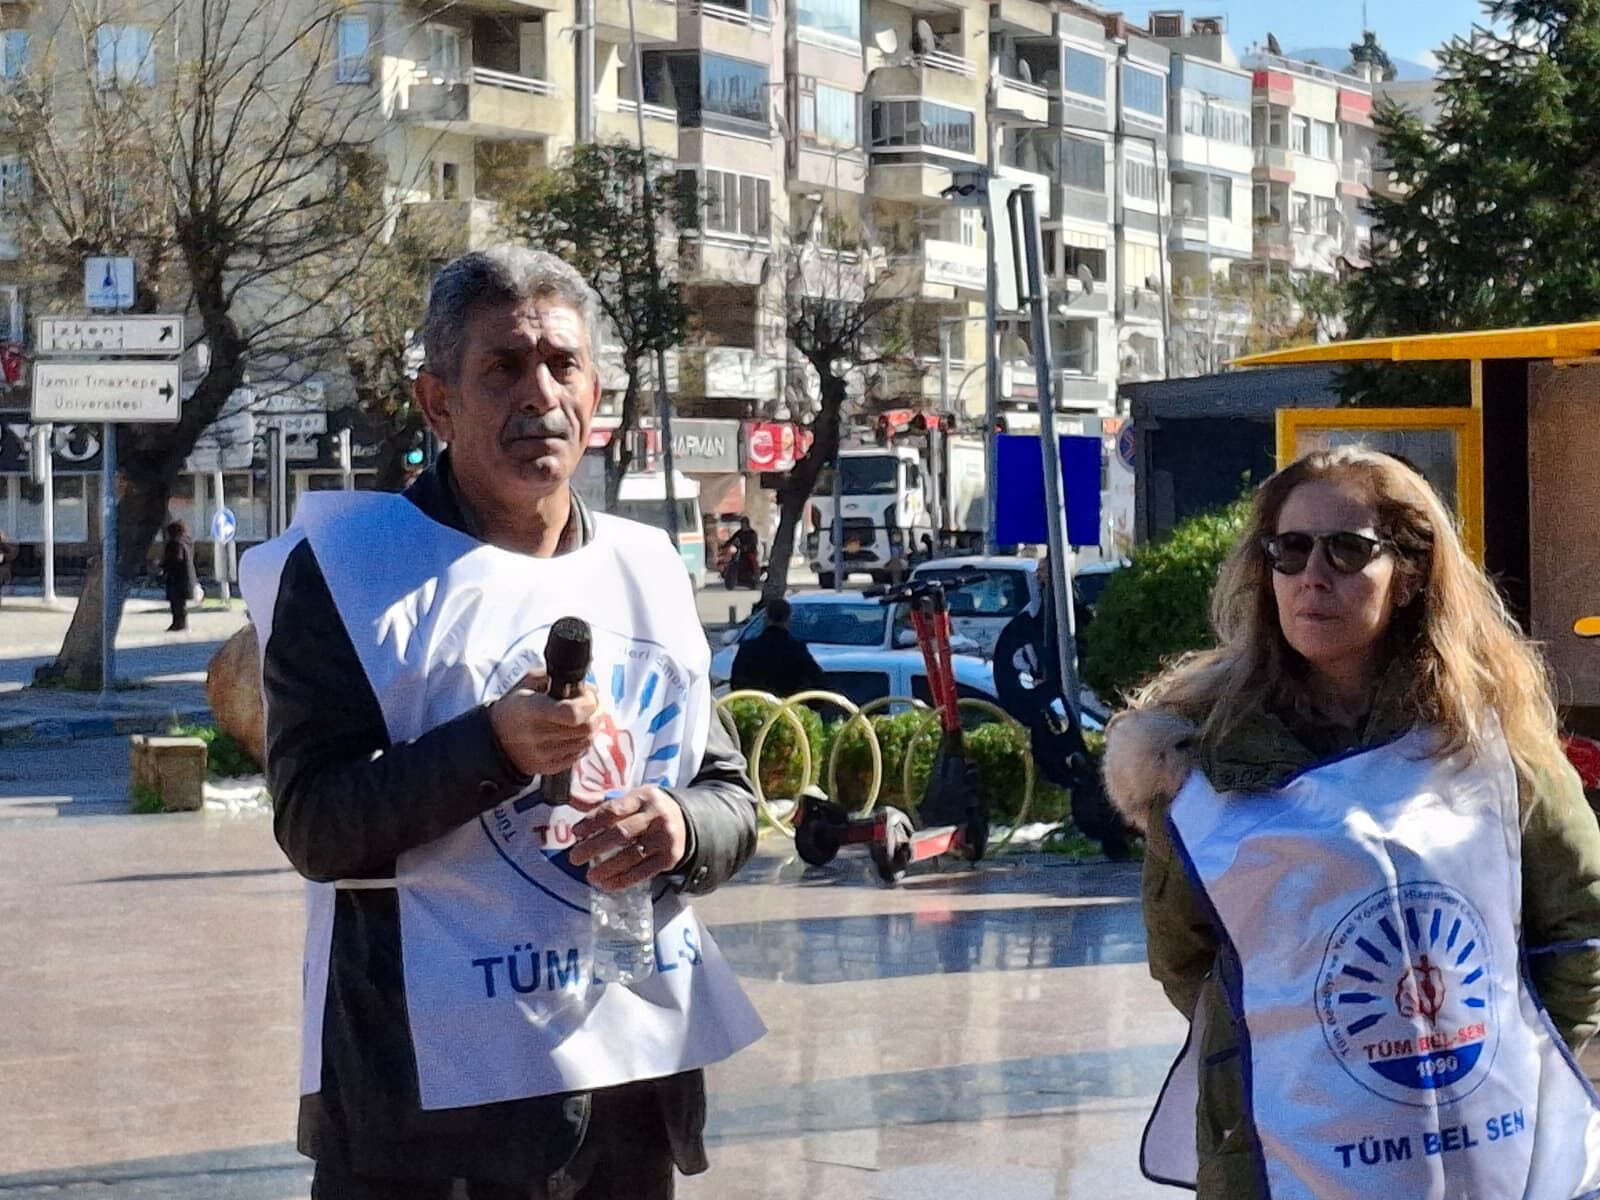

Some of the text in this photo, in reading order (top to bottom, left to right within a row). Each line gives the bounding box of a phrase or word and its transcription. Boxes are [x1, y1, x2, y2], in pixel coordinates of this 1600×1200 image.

[472, 943, 580, 998] TÜM
[1363, 1039, 1413, 1061] TÜM
[1334, 1107, 1525, 1169] TÜM BEL SEN
